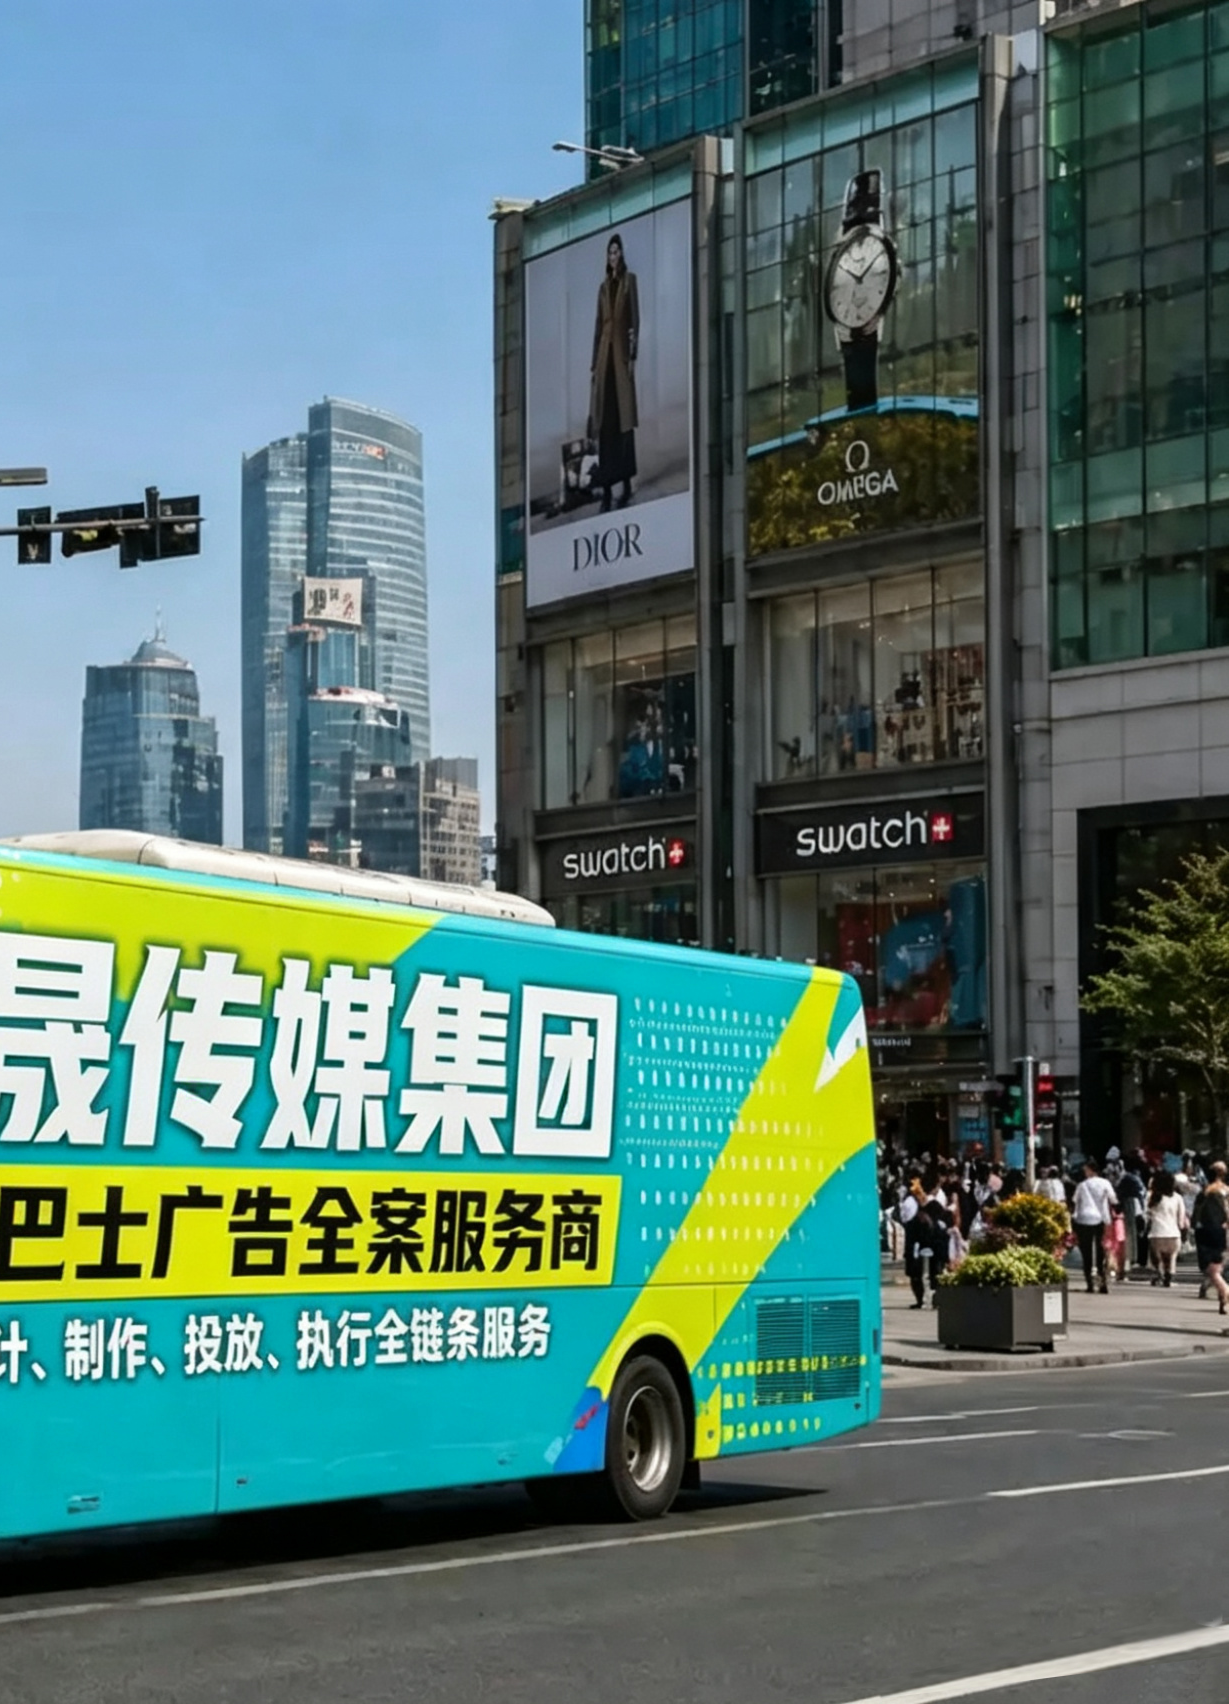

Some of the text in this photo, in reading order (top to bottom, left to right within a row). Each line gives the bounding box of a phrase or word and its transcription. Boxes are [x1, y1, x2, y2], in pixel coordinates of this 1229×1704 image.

[817, 469, 899, 506] OMEGA
[573, 523, 643, 571] DIOR
[796, 811, 926, 856] swatch
[563, 836, 666, 879] swatch
